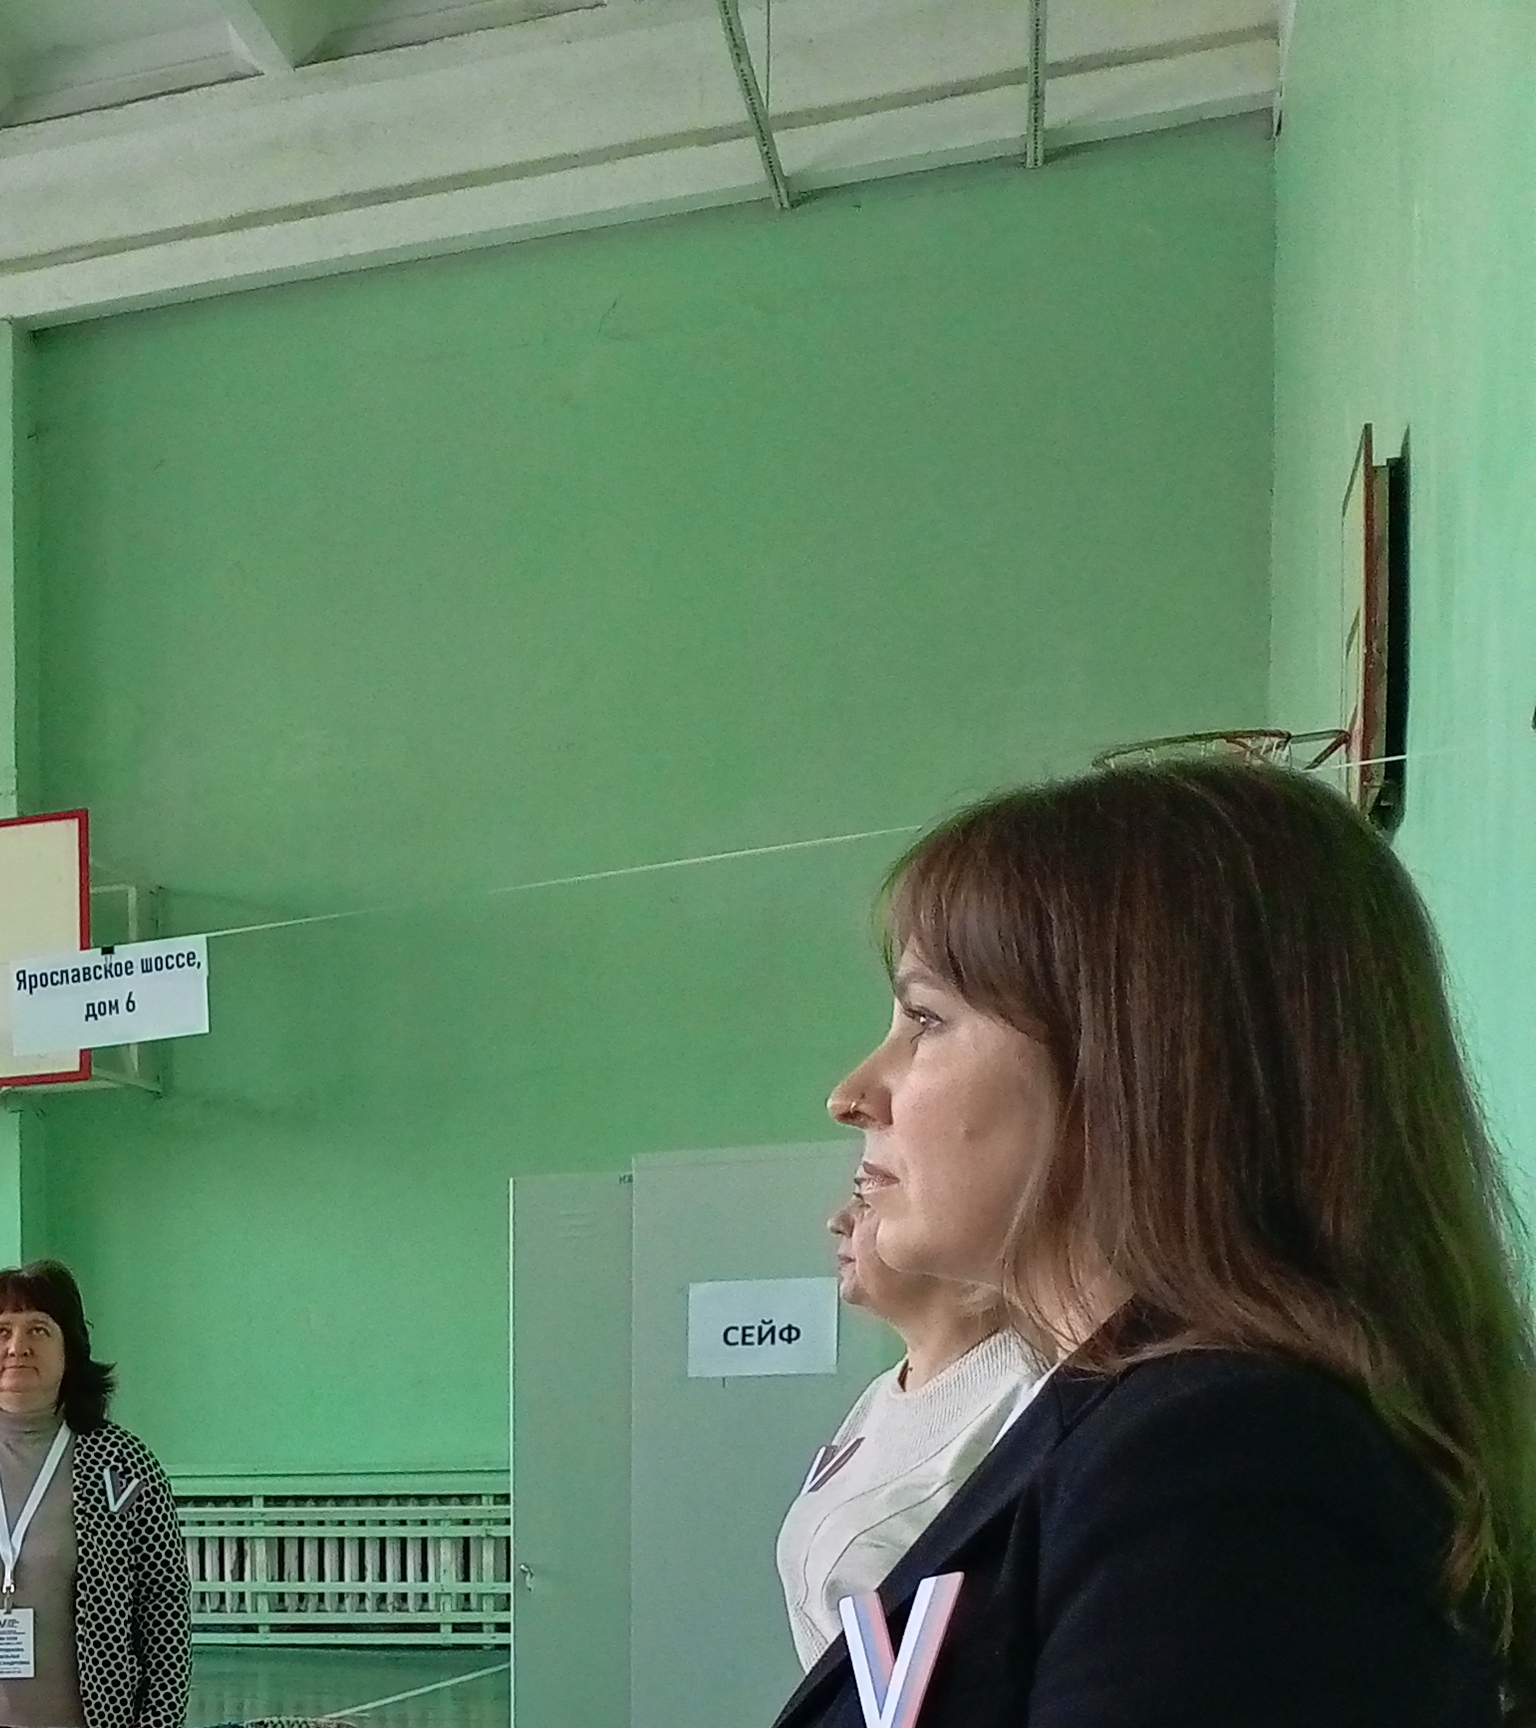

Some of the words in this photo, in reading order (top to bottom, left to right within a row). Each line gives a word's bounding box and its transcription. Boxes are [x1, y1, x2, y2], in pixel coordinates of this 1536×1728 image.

[15, 959, 134, 995] Ярославское
[140, 950, 202, 974] шоссе,
[84, 998, 120, 1022] дом
[125, 991, 136, 1013] 6
[723, 1319, 801, 1346] СЕЙФ
